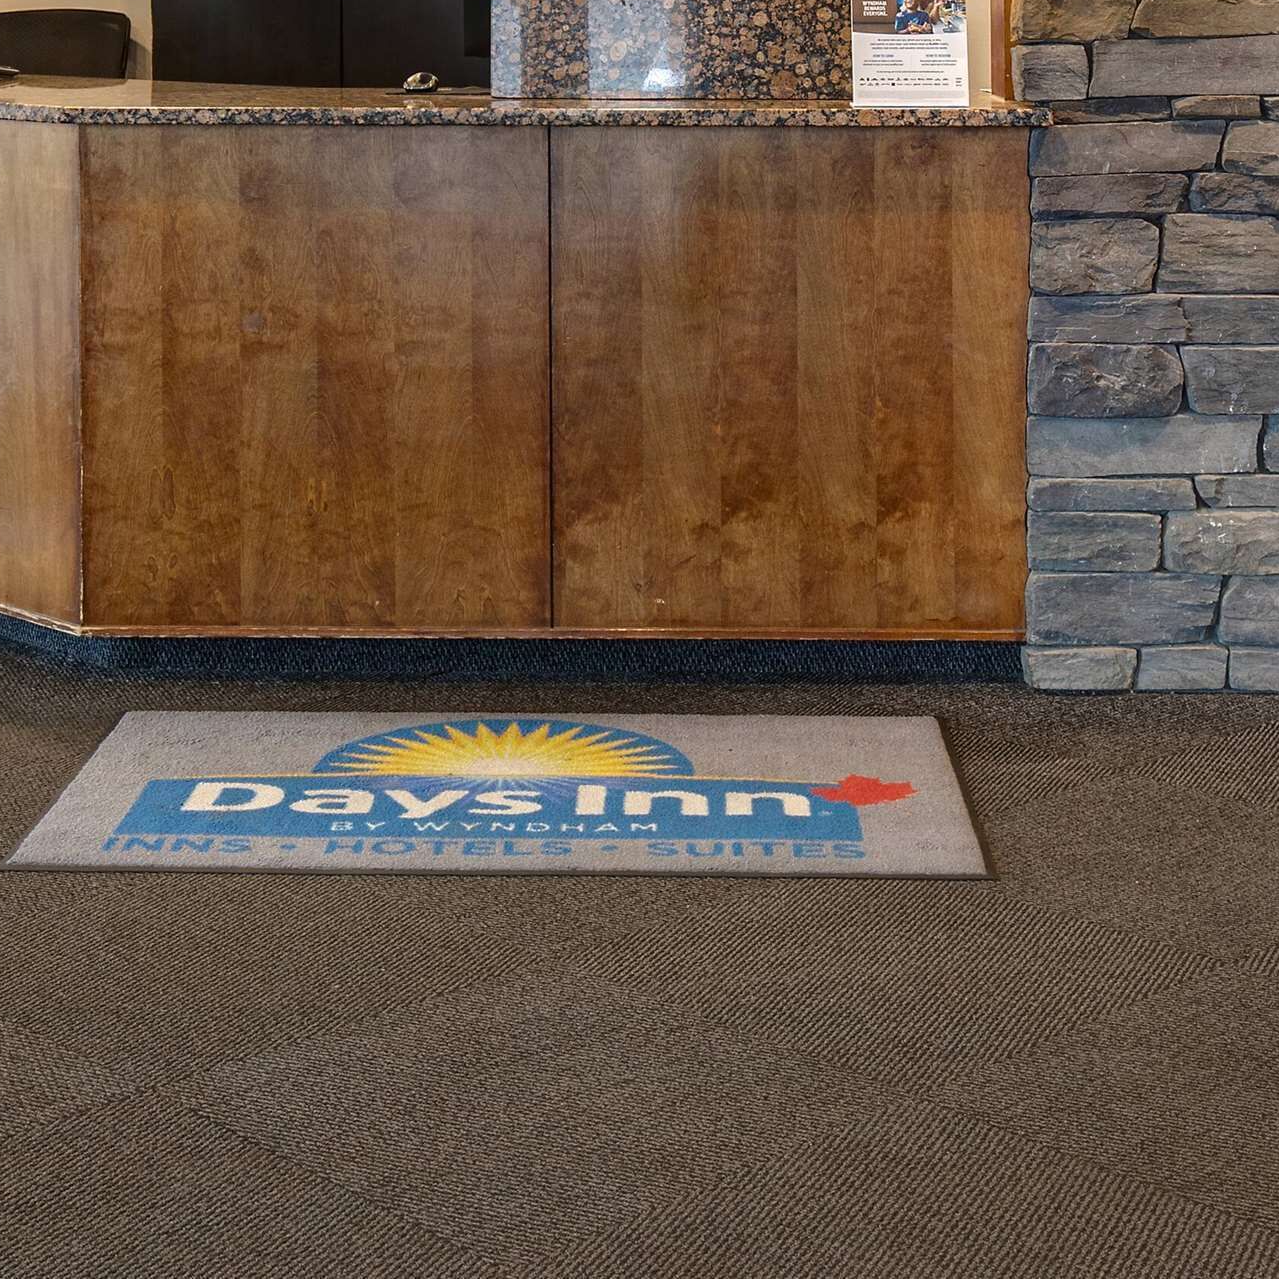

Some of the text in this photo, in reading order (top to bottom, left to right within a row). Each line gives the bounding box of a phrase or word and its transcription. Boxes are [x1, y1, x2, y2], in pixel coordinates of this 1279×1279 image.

[181, 782, 811, 819] Days Inn
[330, 822, 658, 832] BY WYNDHAM
[100, 836, 865, 859] INNS HOTELS SUITES
